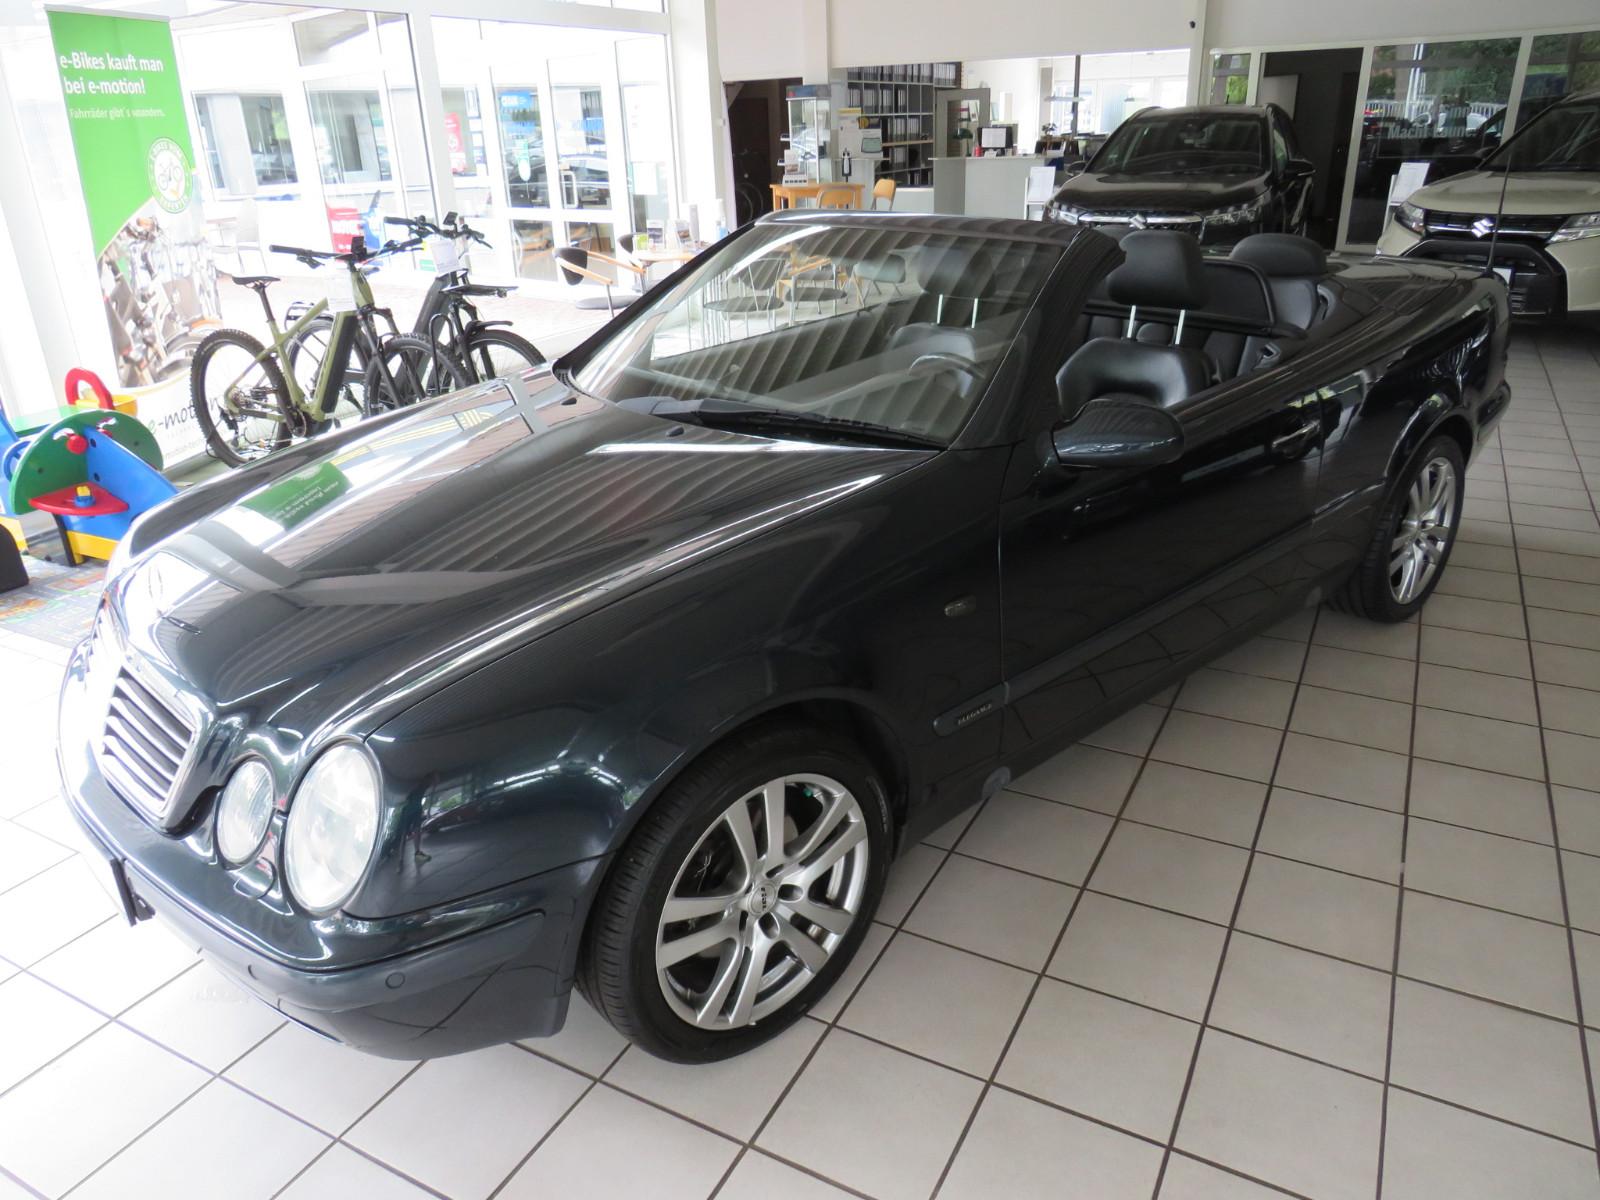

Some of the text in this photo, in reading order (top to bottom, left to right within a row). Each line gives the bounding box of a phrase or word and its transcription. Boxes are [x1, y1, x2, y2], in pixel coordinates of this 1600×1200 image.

[60, 52, 163, 72] e-Bikes kauft man
[64, 77, 145, 95] bei e-motion!
